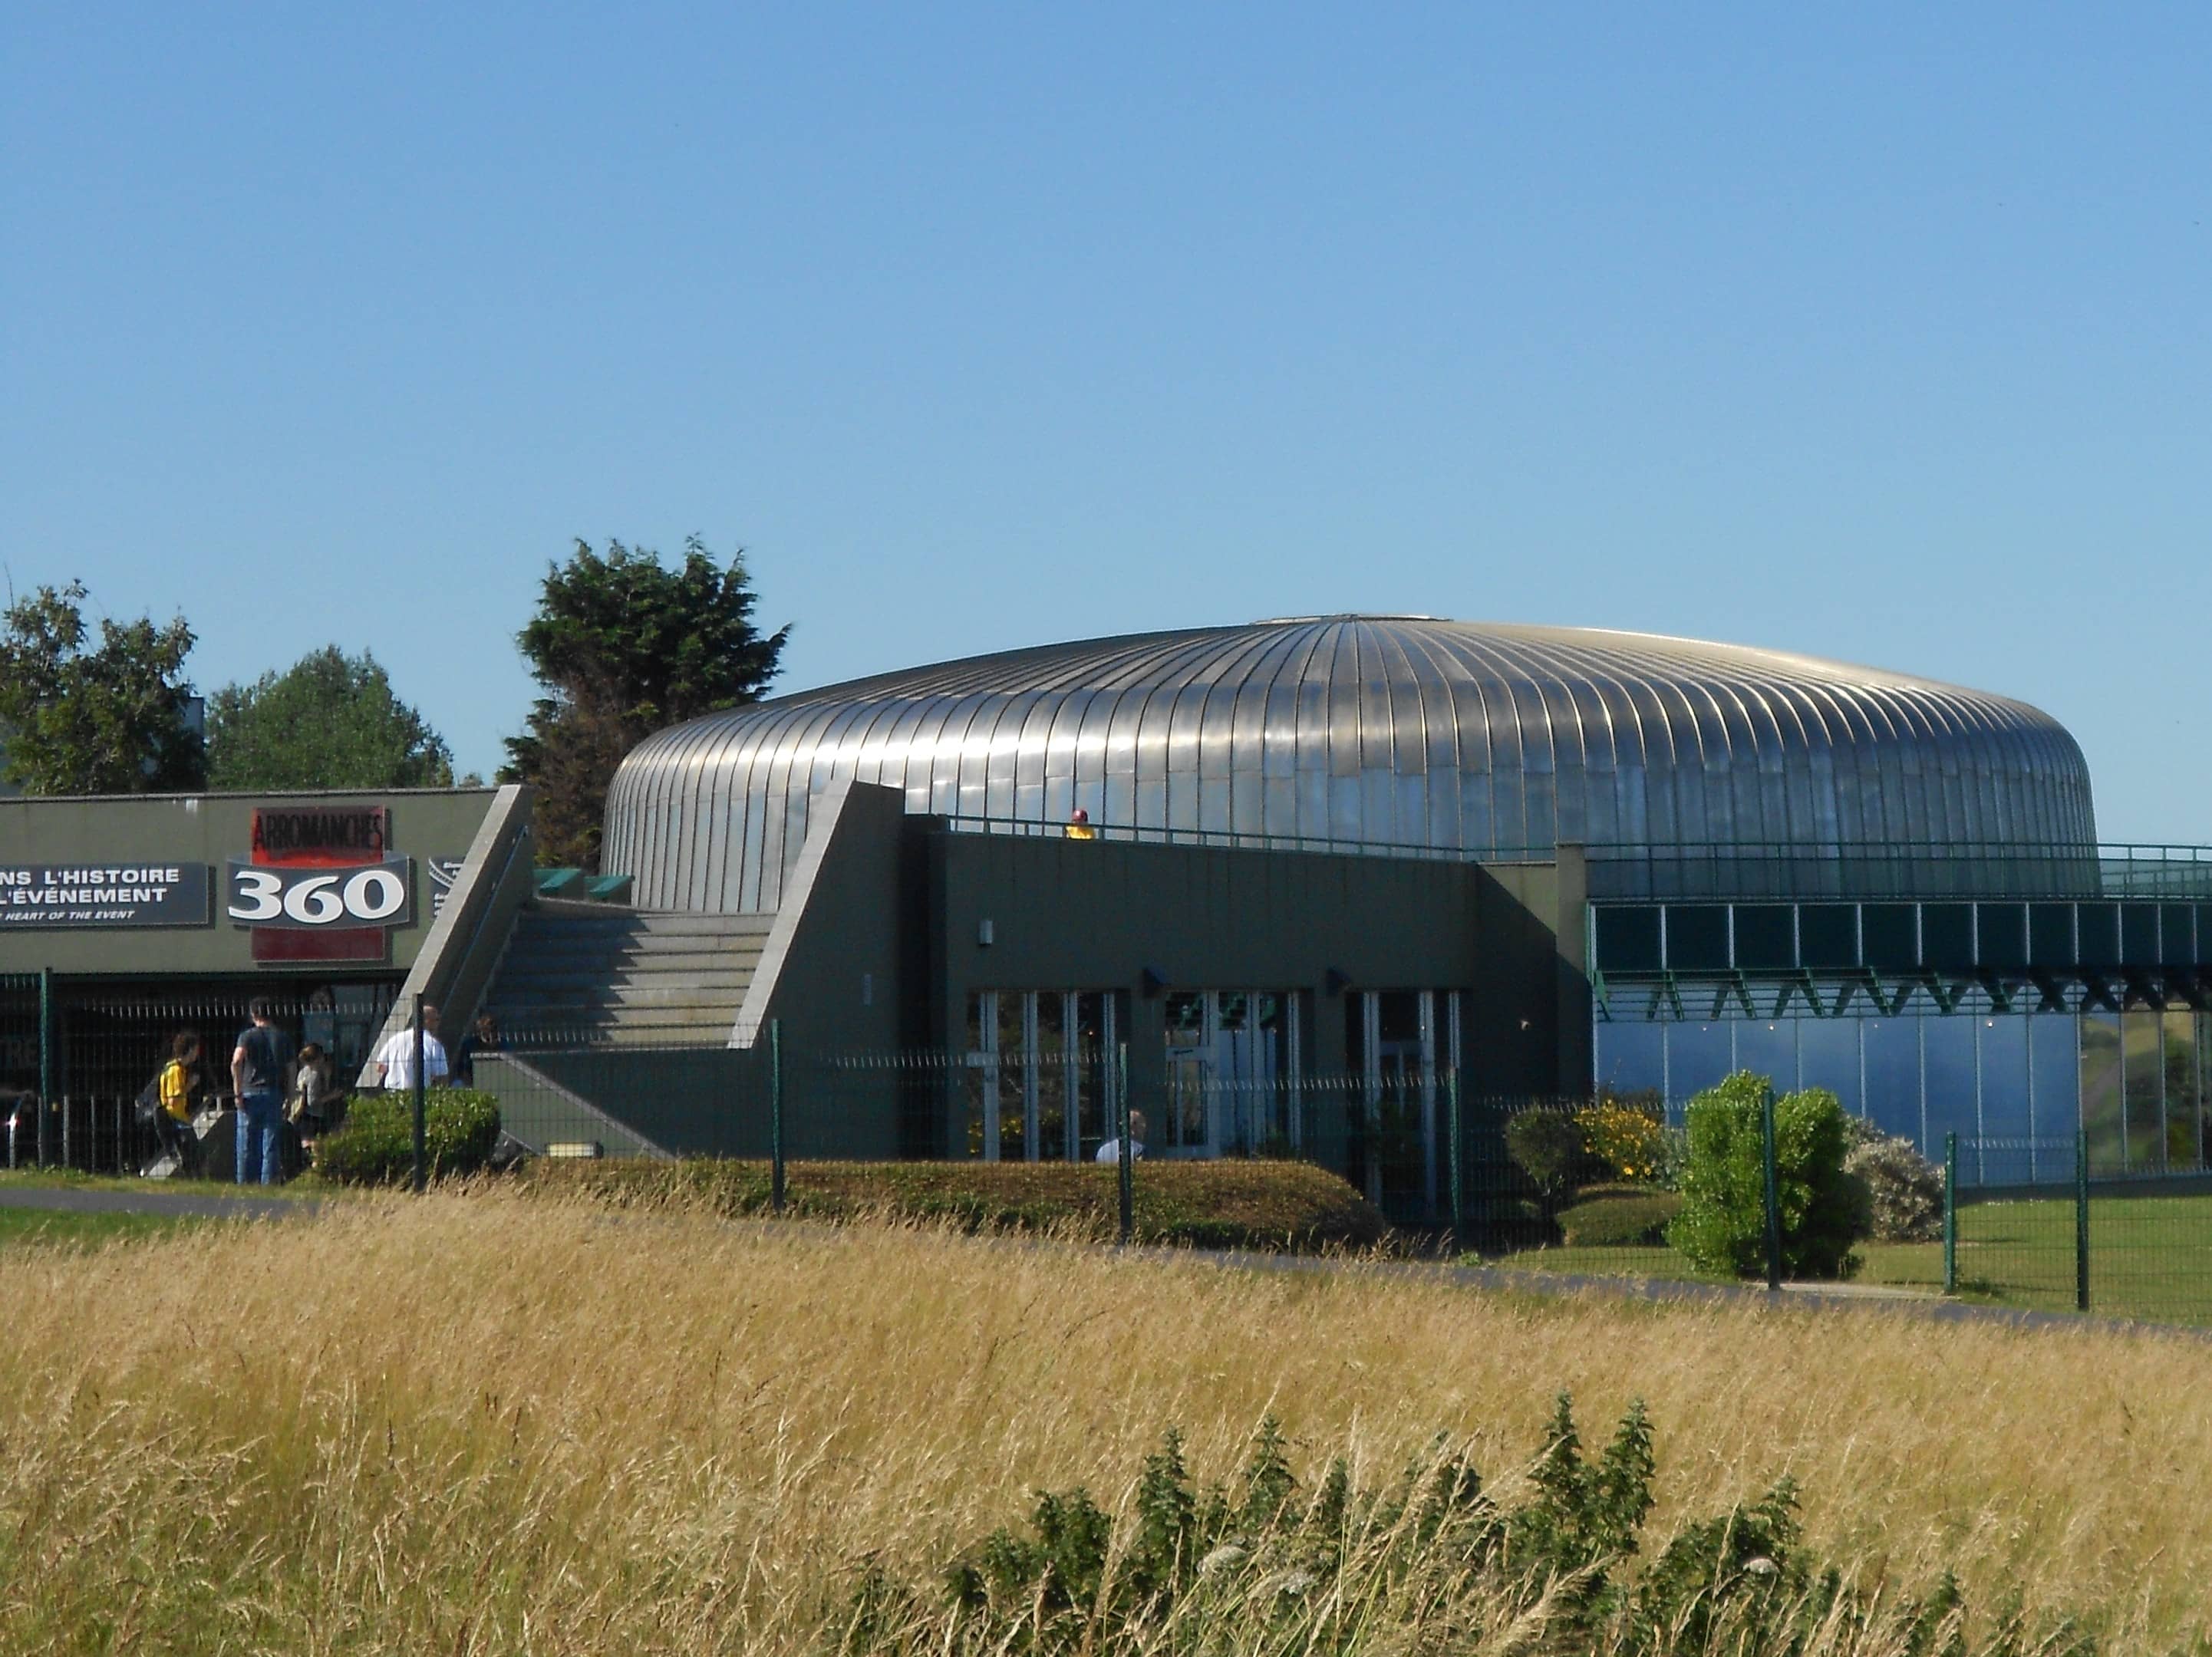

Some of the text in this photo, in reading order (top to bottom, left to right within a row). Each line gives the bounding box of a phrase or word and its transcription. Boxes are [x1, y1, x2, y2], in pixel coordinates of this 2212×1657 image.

[45, 869, 180, 885] L'HISTOIRE
[228, 870, 404, 924] 360
[5, 911, 46, 921] HEART
[48, 911, 65, 920] OF
[69, 911, 93, 920] THE
[94, 911, 135, 919] EVENT
